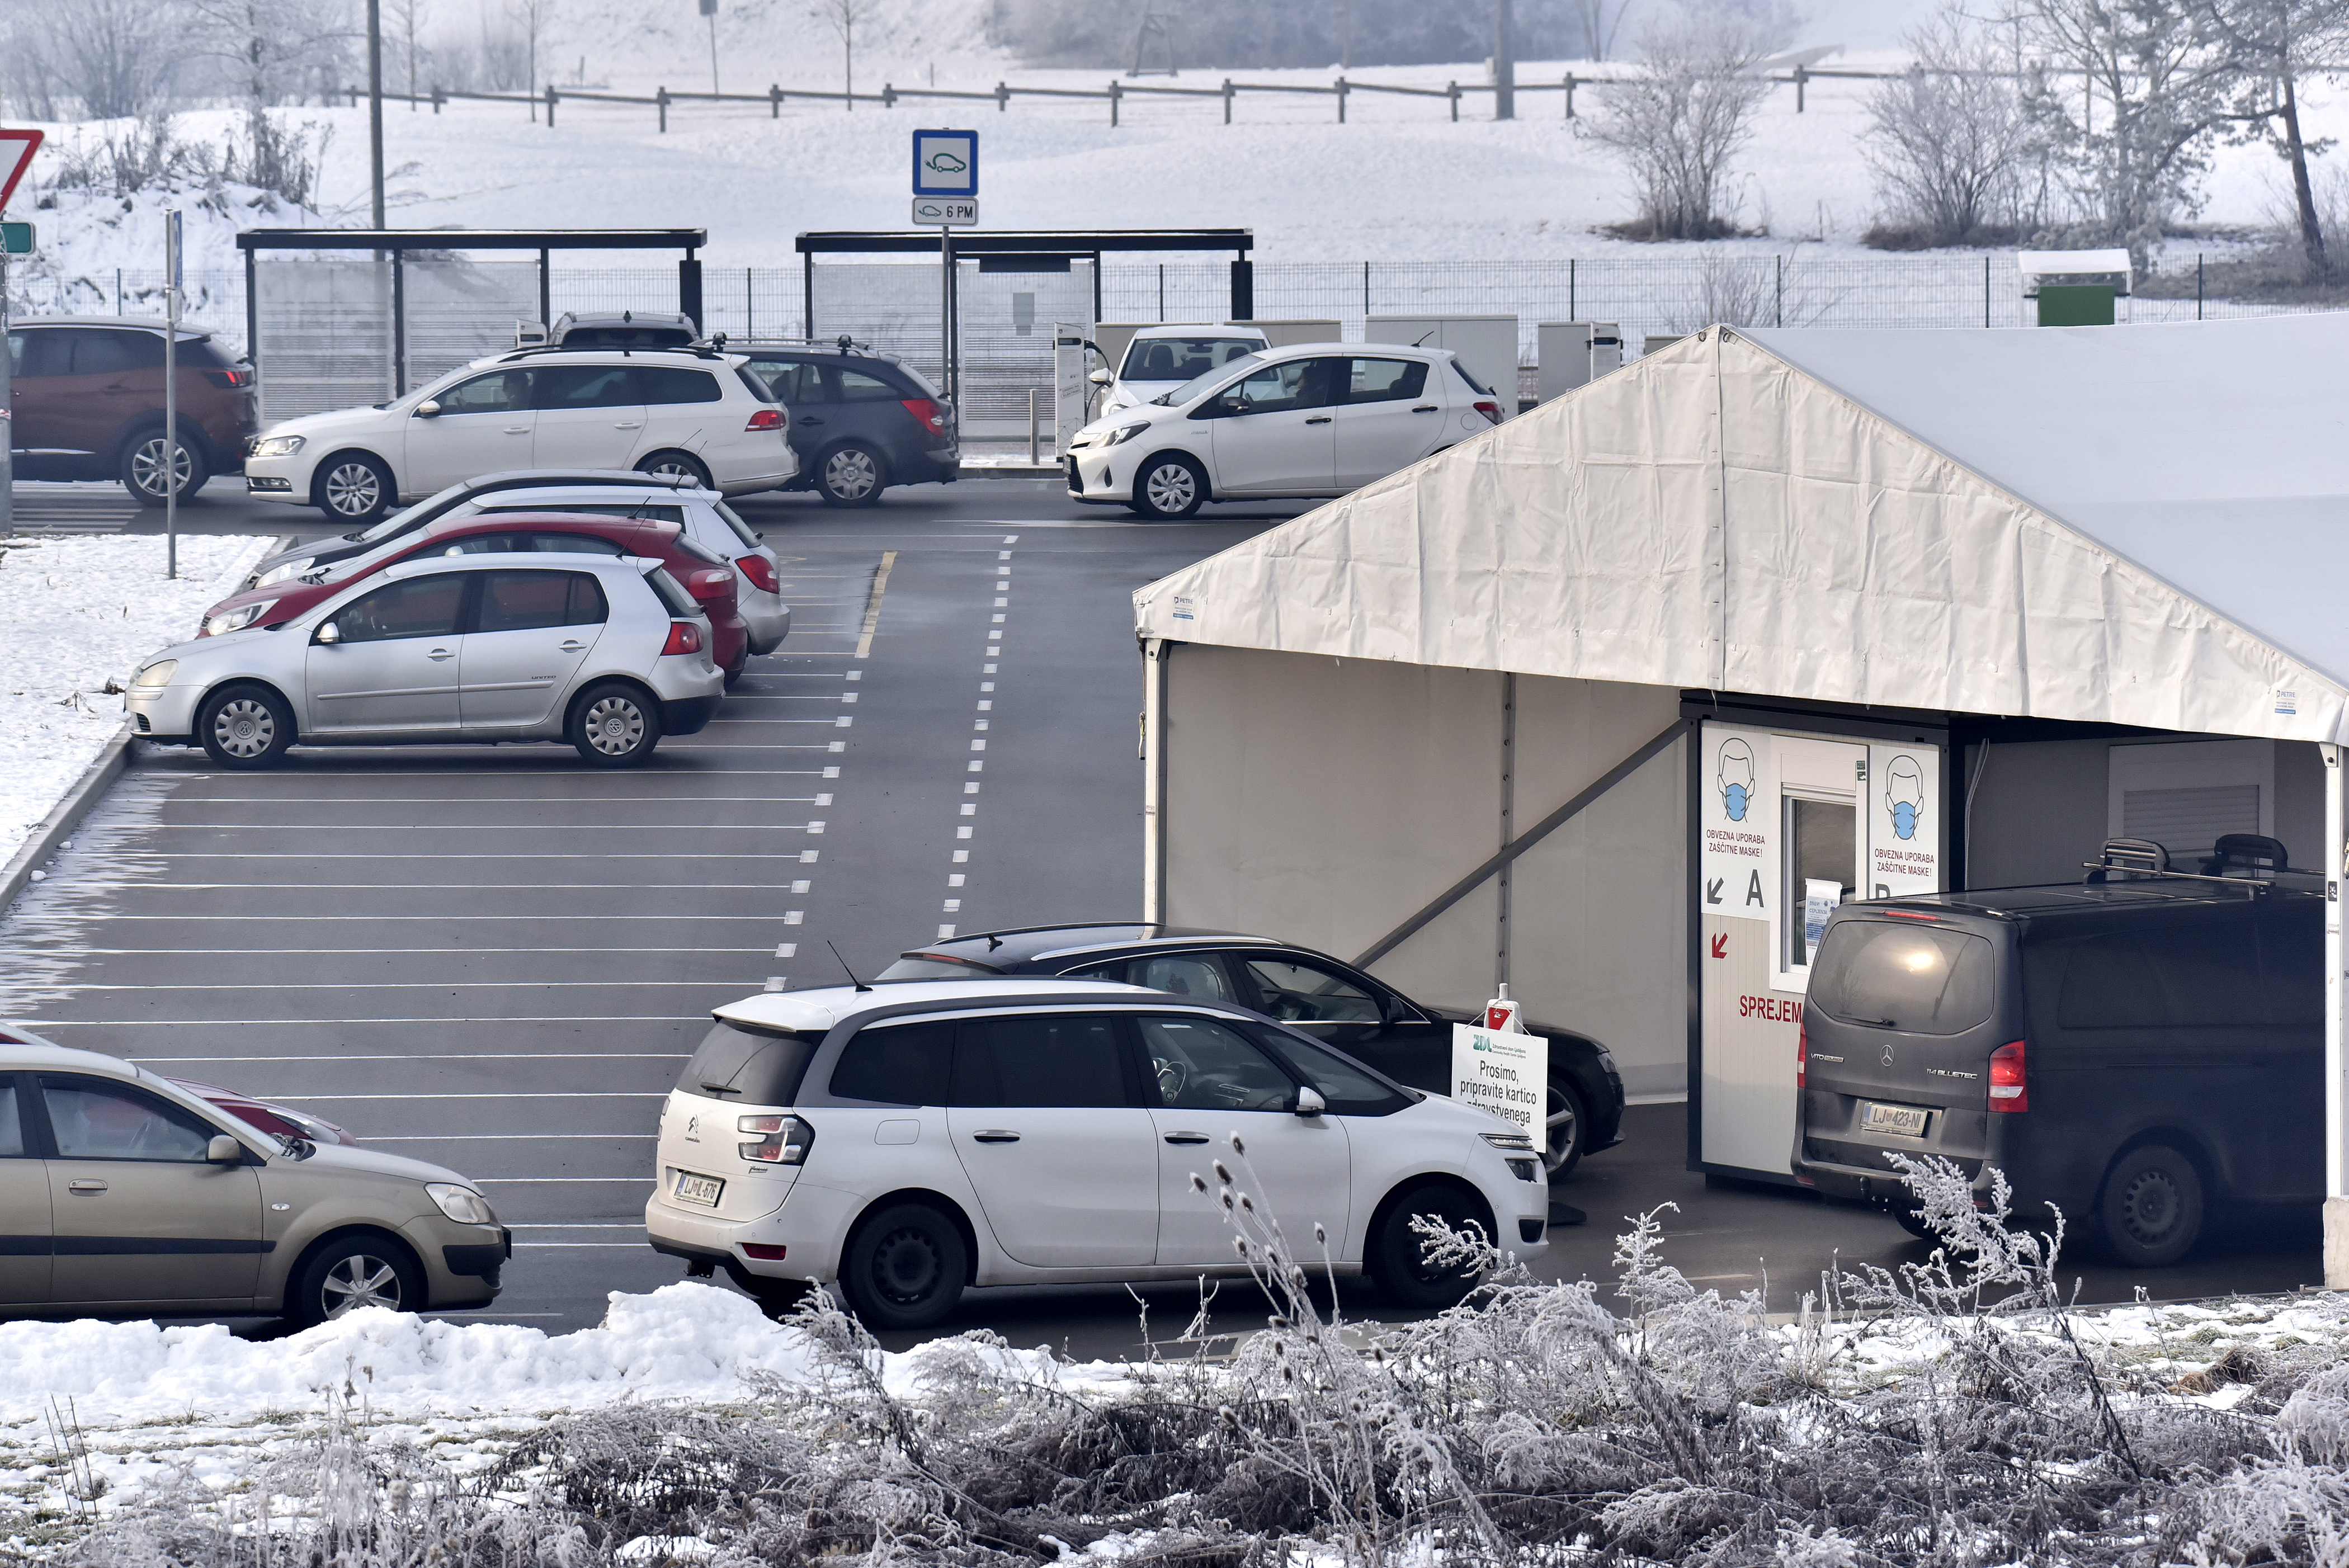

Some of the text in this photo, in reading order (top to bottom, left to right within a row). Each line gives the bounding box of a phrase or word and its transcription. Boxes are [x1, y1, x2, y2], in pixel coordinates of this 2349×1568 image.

[947, 206, 973, 218] 6 PM
[1706, 829, 1765, 845] OBVEZNA UPORABA
[1709, 842, 1763, 858] ZAŠČITNE MASKE!
[1875, 848, 1935, 864] OBVEZNA UPORABA
[1877, 861, 1932, 877] ZAŠČITNE MASKE!
[1746, 869, 1764, 908] A
[1739, 995, 1801, 1023] SPREJEM
[1473, 1034, 1492, 1052] ZDL
[1480, 1060, 1518, 1084] Prosimo,
[1937, 1070, 1978, 1079] BLUETEC
[1460, 1078, 1537, 1105] pripravite kartico
[1467, 1098, 1530, 1127] vstvenega
[1872, 1108, 1886, 1123] LJ
[684, 1178, 695, 1194] LJ
